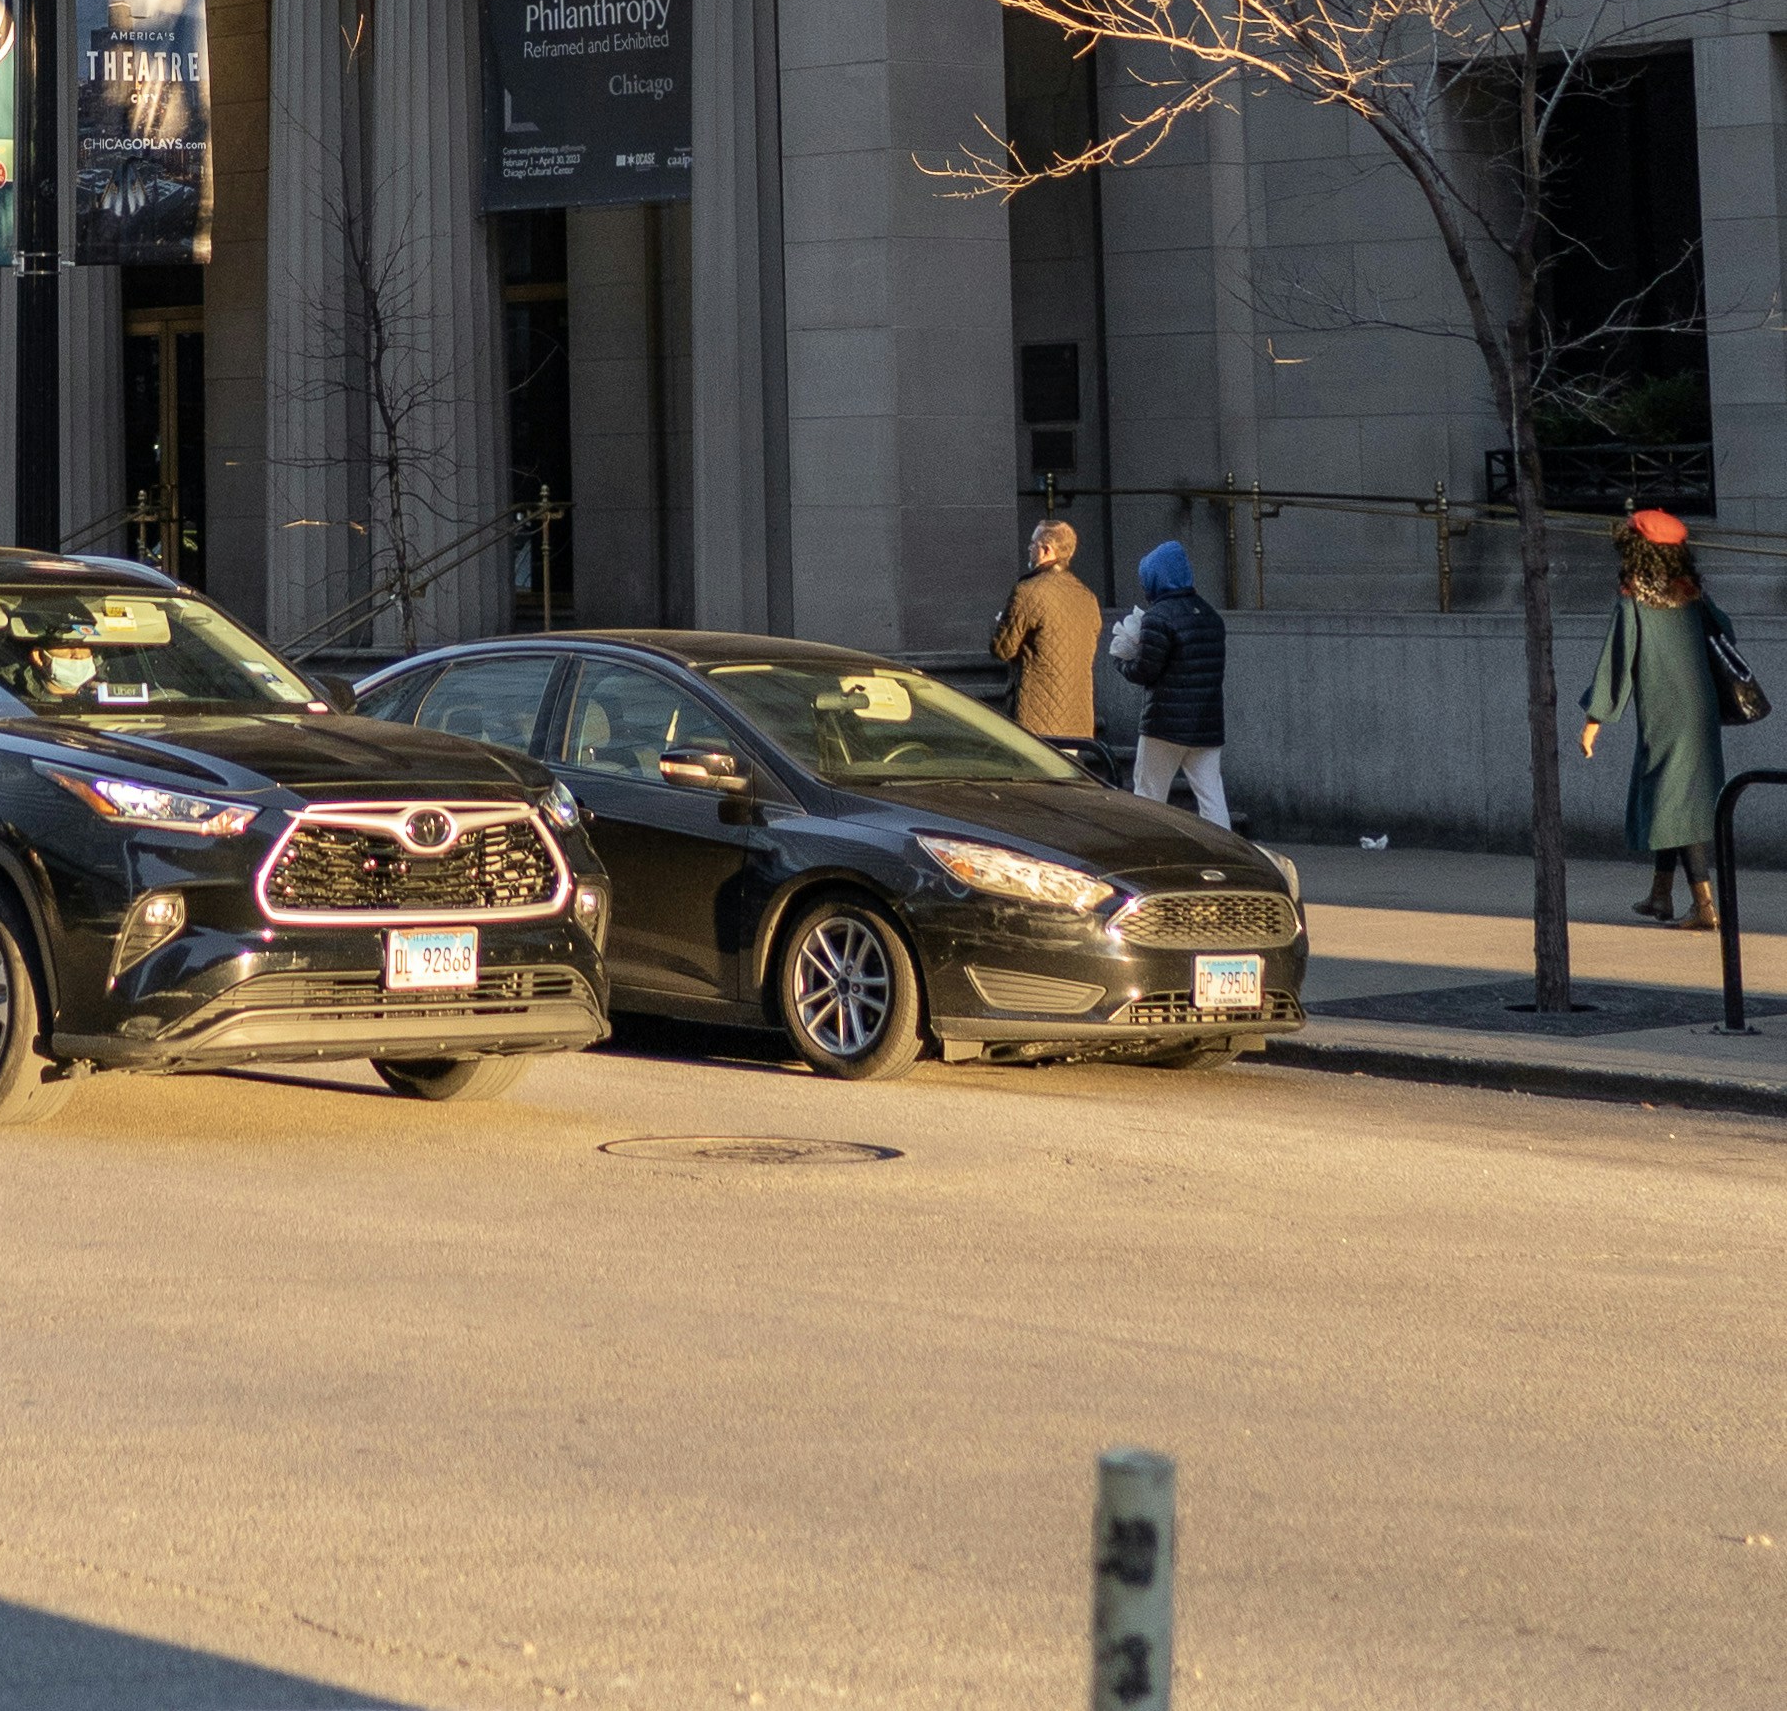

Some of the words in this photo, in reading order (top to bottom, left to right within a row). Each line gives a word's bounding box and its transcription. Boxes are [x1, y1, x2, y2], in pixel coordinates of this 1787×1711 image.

[110, 31, 175, 41] AMERICA'S
[523, 37, 584, 59] Reframed
[587, 34, 610, 54] and
[614, 29, 670, 52] Exhibited
[86, 50, 201, 82] THEATRE
[608, 73, 674, 101] Chicago
[130, 93, 159, 104] CITY
[83, 137, 207, 151] CHICAGOPLAYS.com
[502, 157, 529, 168] February
[539, 156, 555, 167] April
[113, 685, 137, 697] Uber
[395, 948, 412, 974] DL
[423, 946, 471, 973] 92868
[1219, 971, 1257, 995] 29503
